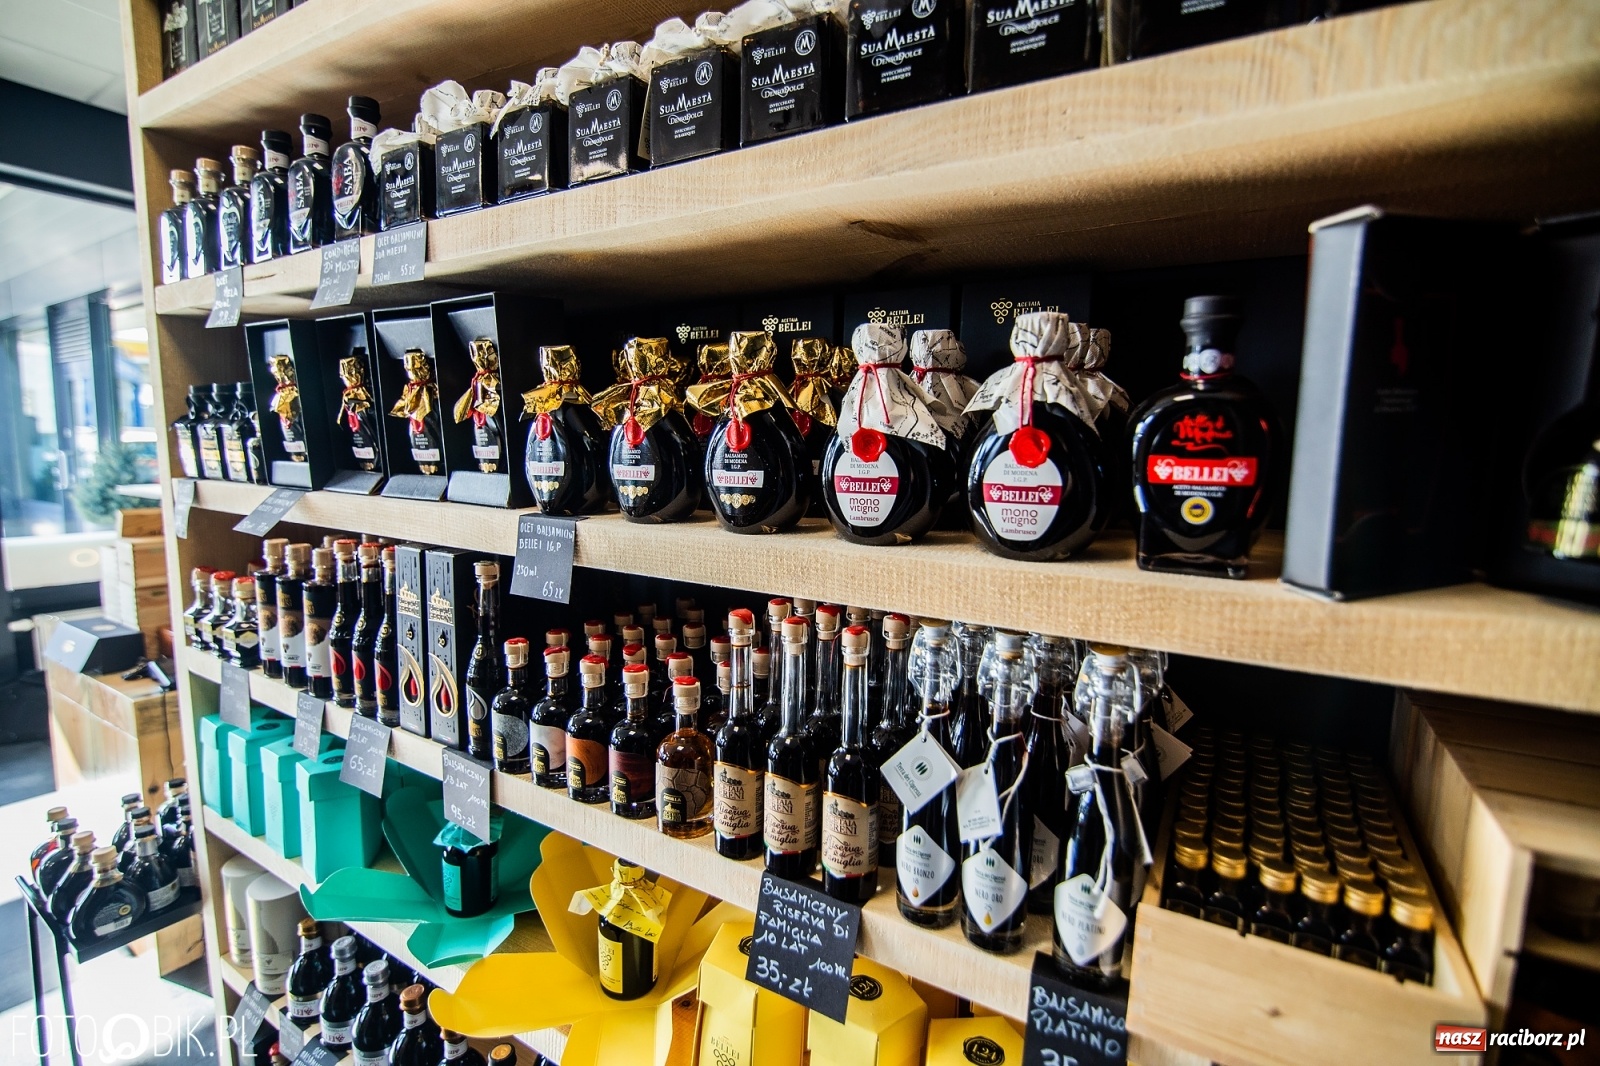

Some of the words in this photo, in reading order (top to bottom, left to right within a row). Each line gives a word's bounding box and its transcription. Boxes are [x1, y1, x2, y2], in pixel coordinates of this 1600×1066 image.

[876, 9, 901, 23] BELLEI
[987, 9, 1012, 24] SUA
[764, 47, 786, 59] BELLEI
[861, 41, 882, 56] SUA
[752, 76, 770, 88] SUA
[660, 105, 675, 115] SUA
[576, 128, 590, 137] SUA
[504, 148, 516, 157] SUA
[344, 157, 354, 195] SABA
[441, 166, 453, 174] SUA
[295, 172, 304, 208] SABA
[386, 182, 396, 190] SUA
[335, 260, 359, 273] MOSTO
[886, 313, 925, 325] BELLEI
[778, 321, 812, 333] BELLEI
[690, 329, 719, 340] BELLEI
[1172, 466, 1229, 481] BELLEI
[724, 475, 749, 485] BELLEI
[850, 482, 880, 493] BELLEI
[849, 497, 880, 506] mono
[1001, 490, 1039, 502] BELLEI
[849, 505, 880, 515] vitigno
[1001, 508, 1038, 518] mono
[1001, 516, 1038, 527] vitigno
[519, 538, 542, 549] BELLEI
[455, 778, 469, 790] LAT
[913, 867, 935, 879] BRONZO
[975, 888, 988, 901] NERO
[755, 930, 777, 944] 10
[781, 937, 808, 955] LAT
